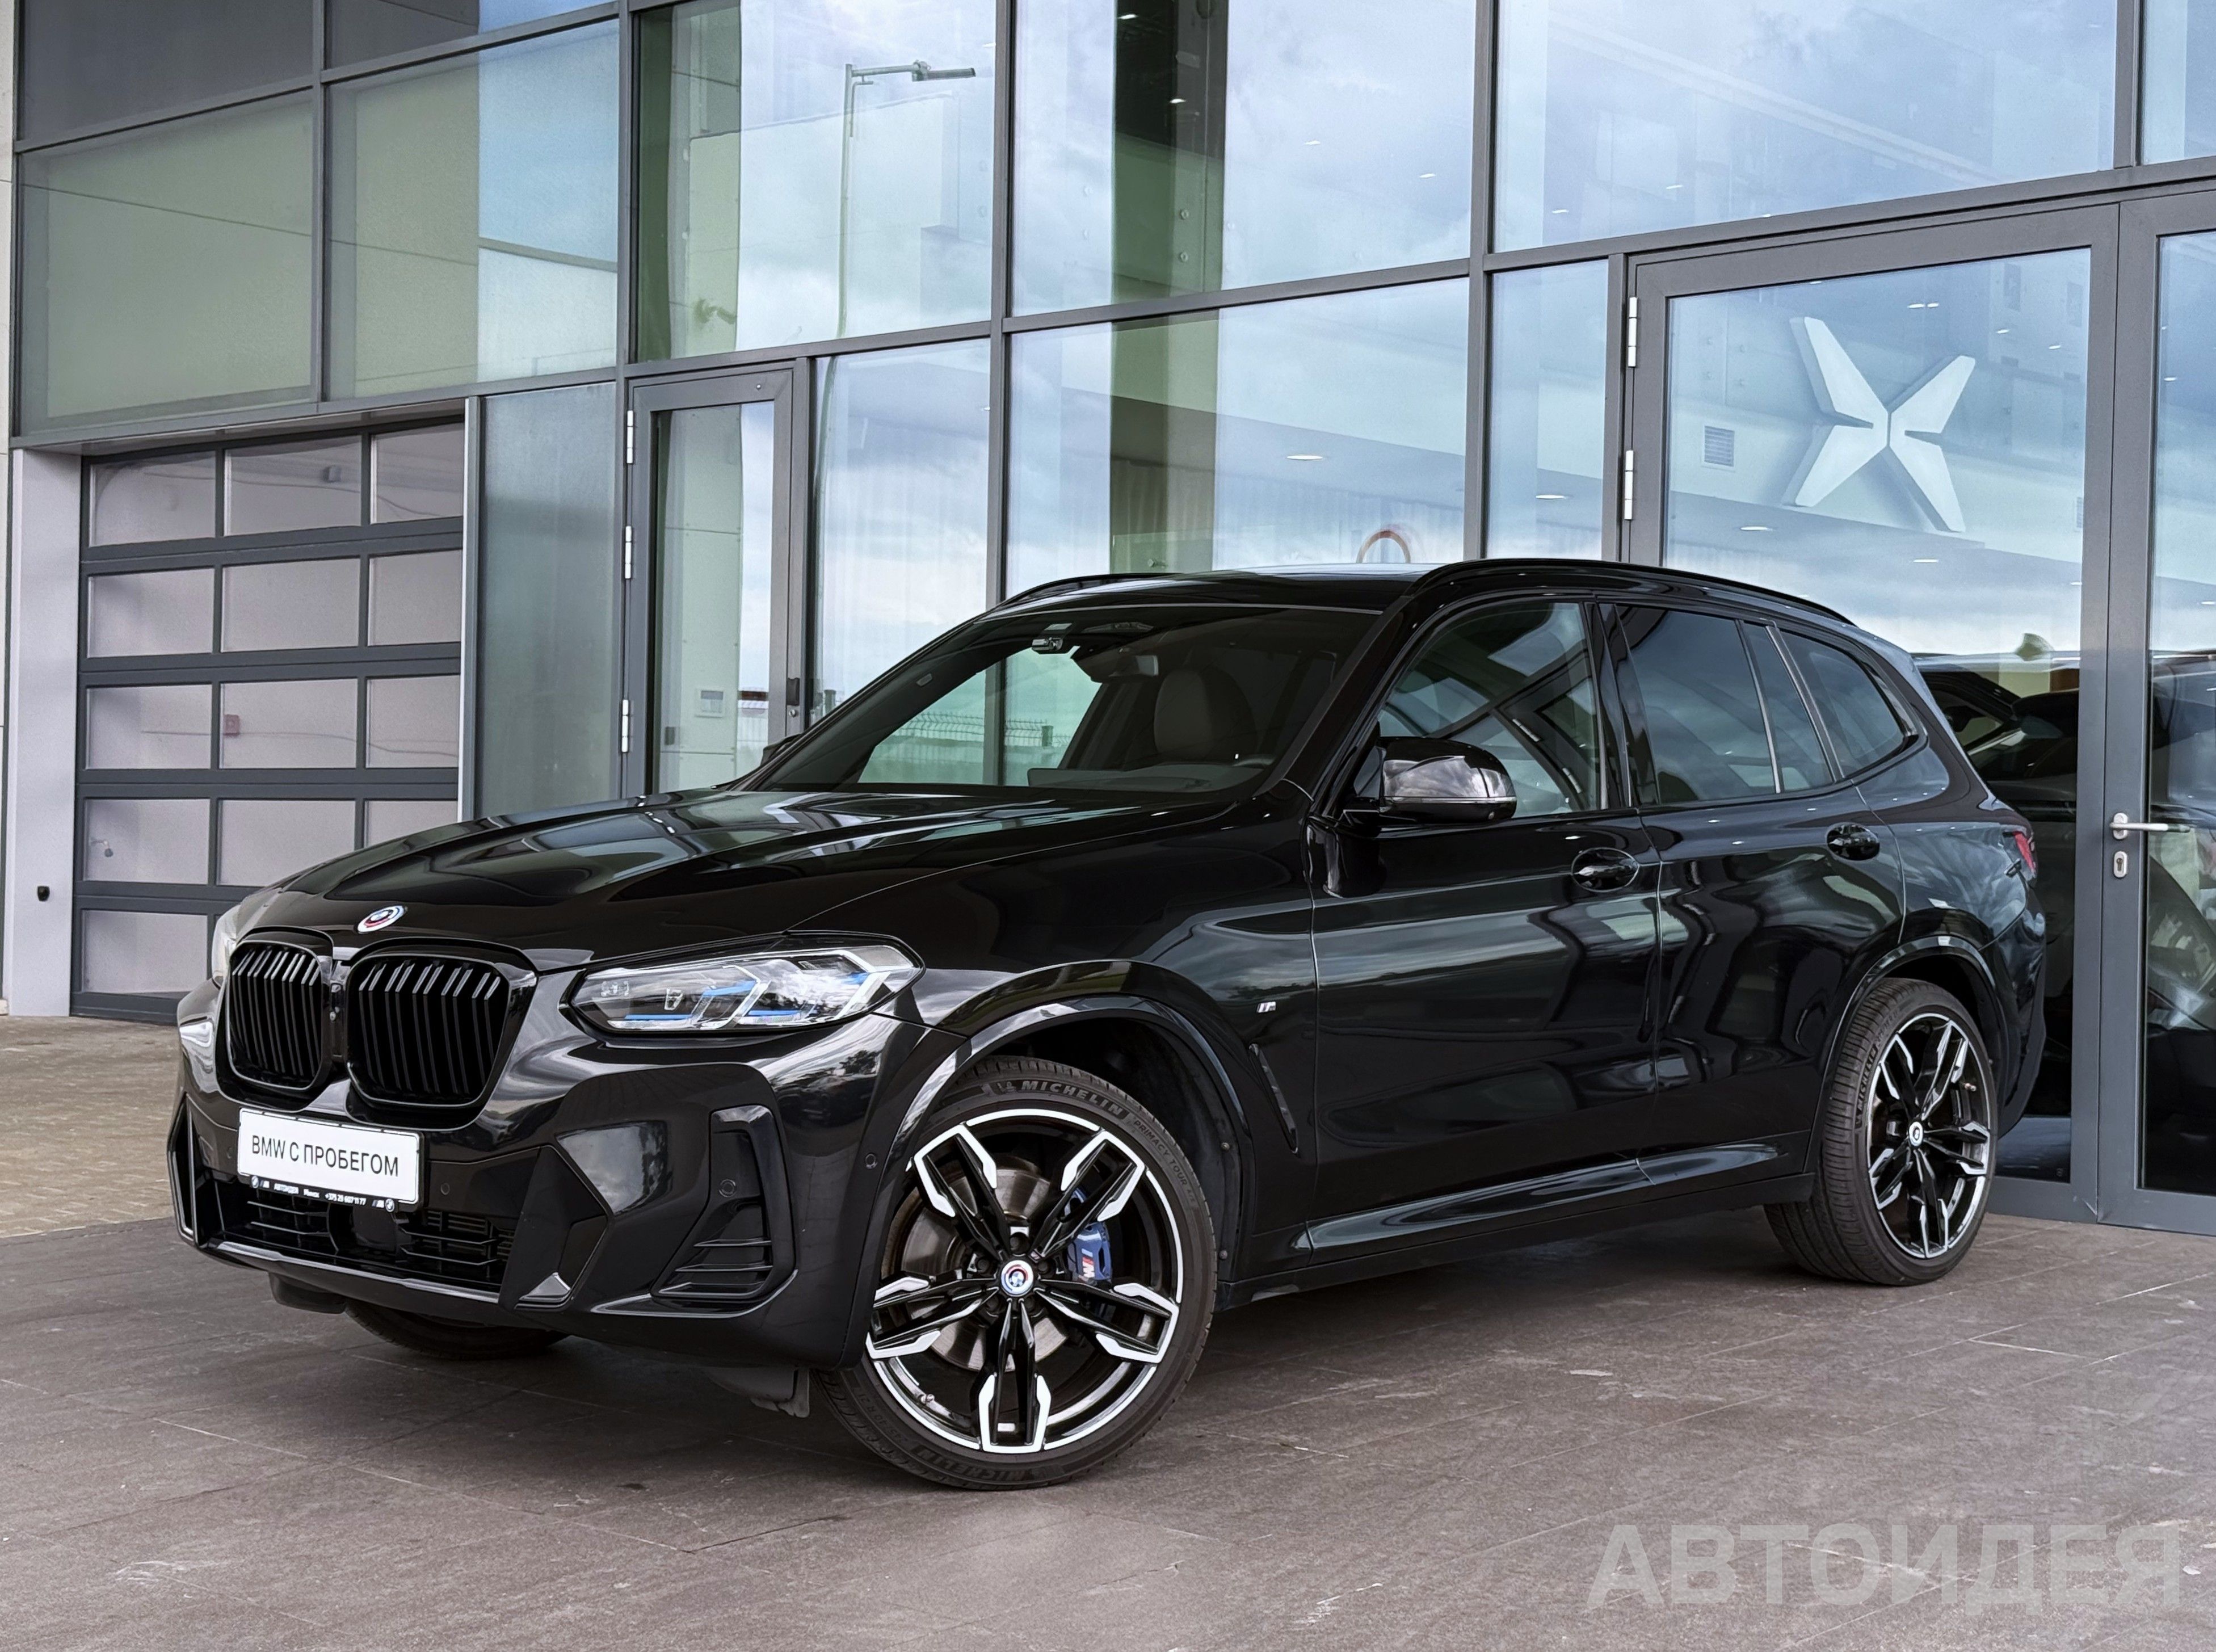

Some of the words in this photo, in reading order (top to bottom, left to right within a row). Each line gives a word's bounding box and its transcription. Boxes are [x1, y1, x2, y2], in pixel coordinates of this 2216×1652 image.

[1021, 1081, 1124, 1116] MICHELIN
[252, 1135, 285, 1159] BMW
[289, 1142, 299, 1161] С
[304, 1144, 398, 1177] ПРОБЕГОМ
[1133, 1120, 1170, 1155] PRIMACY
[1169, 1159, 1188, 1186] TOUR
